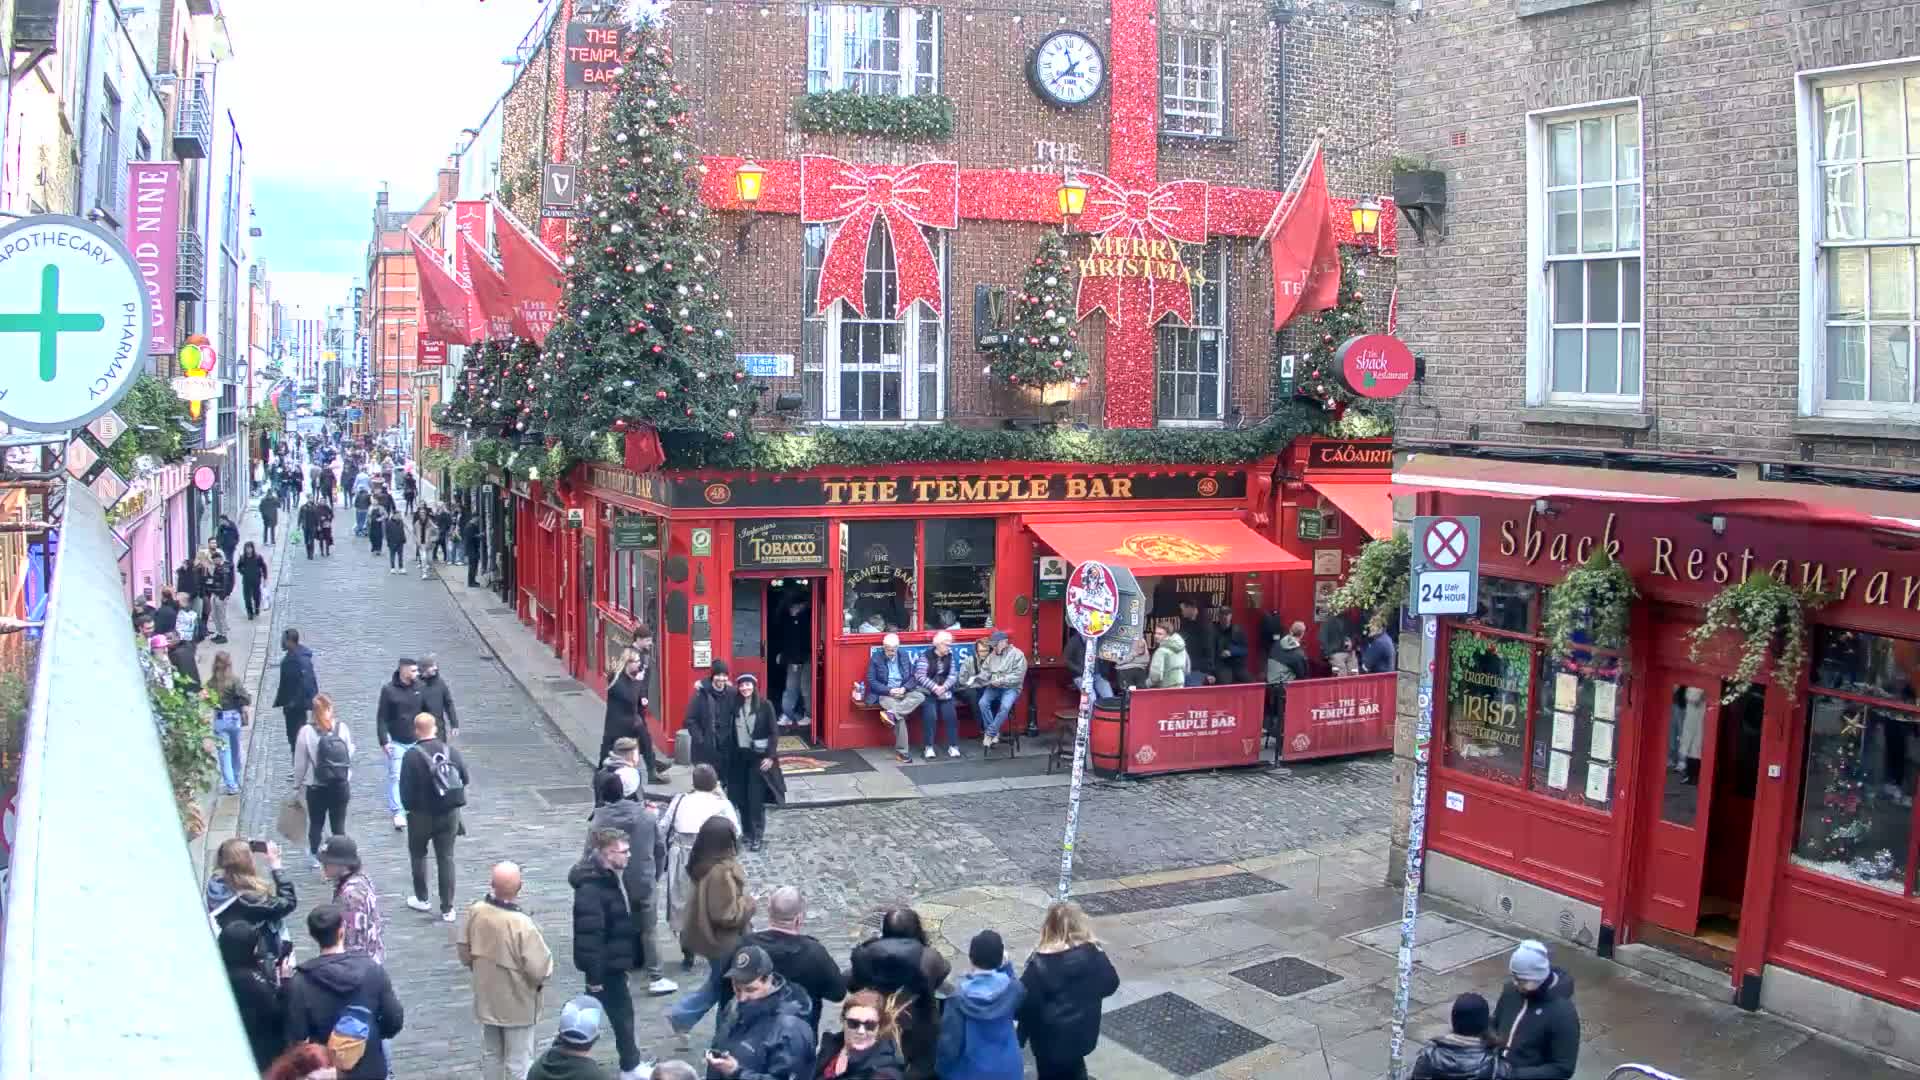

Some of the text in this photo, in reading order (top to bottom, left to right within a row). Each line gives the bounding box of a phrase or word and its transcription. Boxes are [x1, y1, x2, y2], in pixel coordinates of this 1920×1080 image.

[585, 28, 618, 44] THE
[1032, 139, 1082, 162] THE
[136, 170, 169, 232] NINE
[0, 231, 113, 265] APOTHECARY
[1089, 236, 1181, 261] MERRY
[1079, 257, 1206, 286] HRISTMAS
[87, 302, 136, 401] PHARMACY
[1355, 348, 1388, 371] Shack
[636, 476, 653, 498] BAR
[823, 481, 897, 504] THE
[912, 478, 1049, 503] TEMPLE
[1065, 477, 1132, 499] BAR
[1499, 504, 1623, 565] Shack
[748, 537, 816, 562] TOBACCO
[847, 564, 891, 588] TEMPLE
[1421, 583, 1443, 603] 24
[1443, 593, 1466, 602] HOUR
[1188, 709, 1209, 719] THE
[1310, 703, 1380, 721] TEMPLE BAR
[1339, 698, 1356, 708] THE
[1157, 716, 1237, 732] TEMPLE BAR
